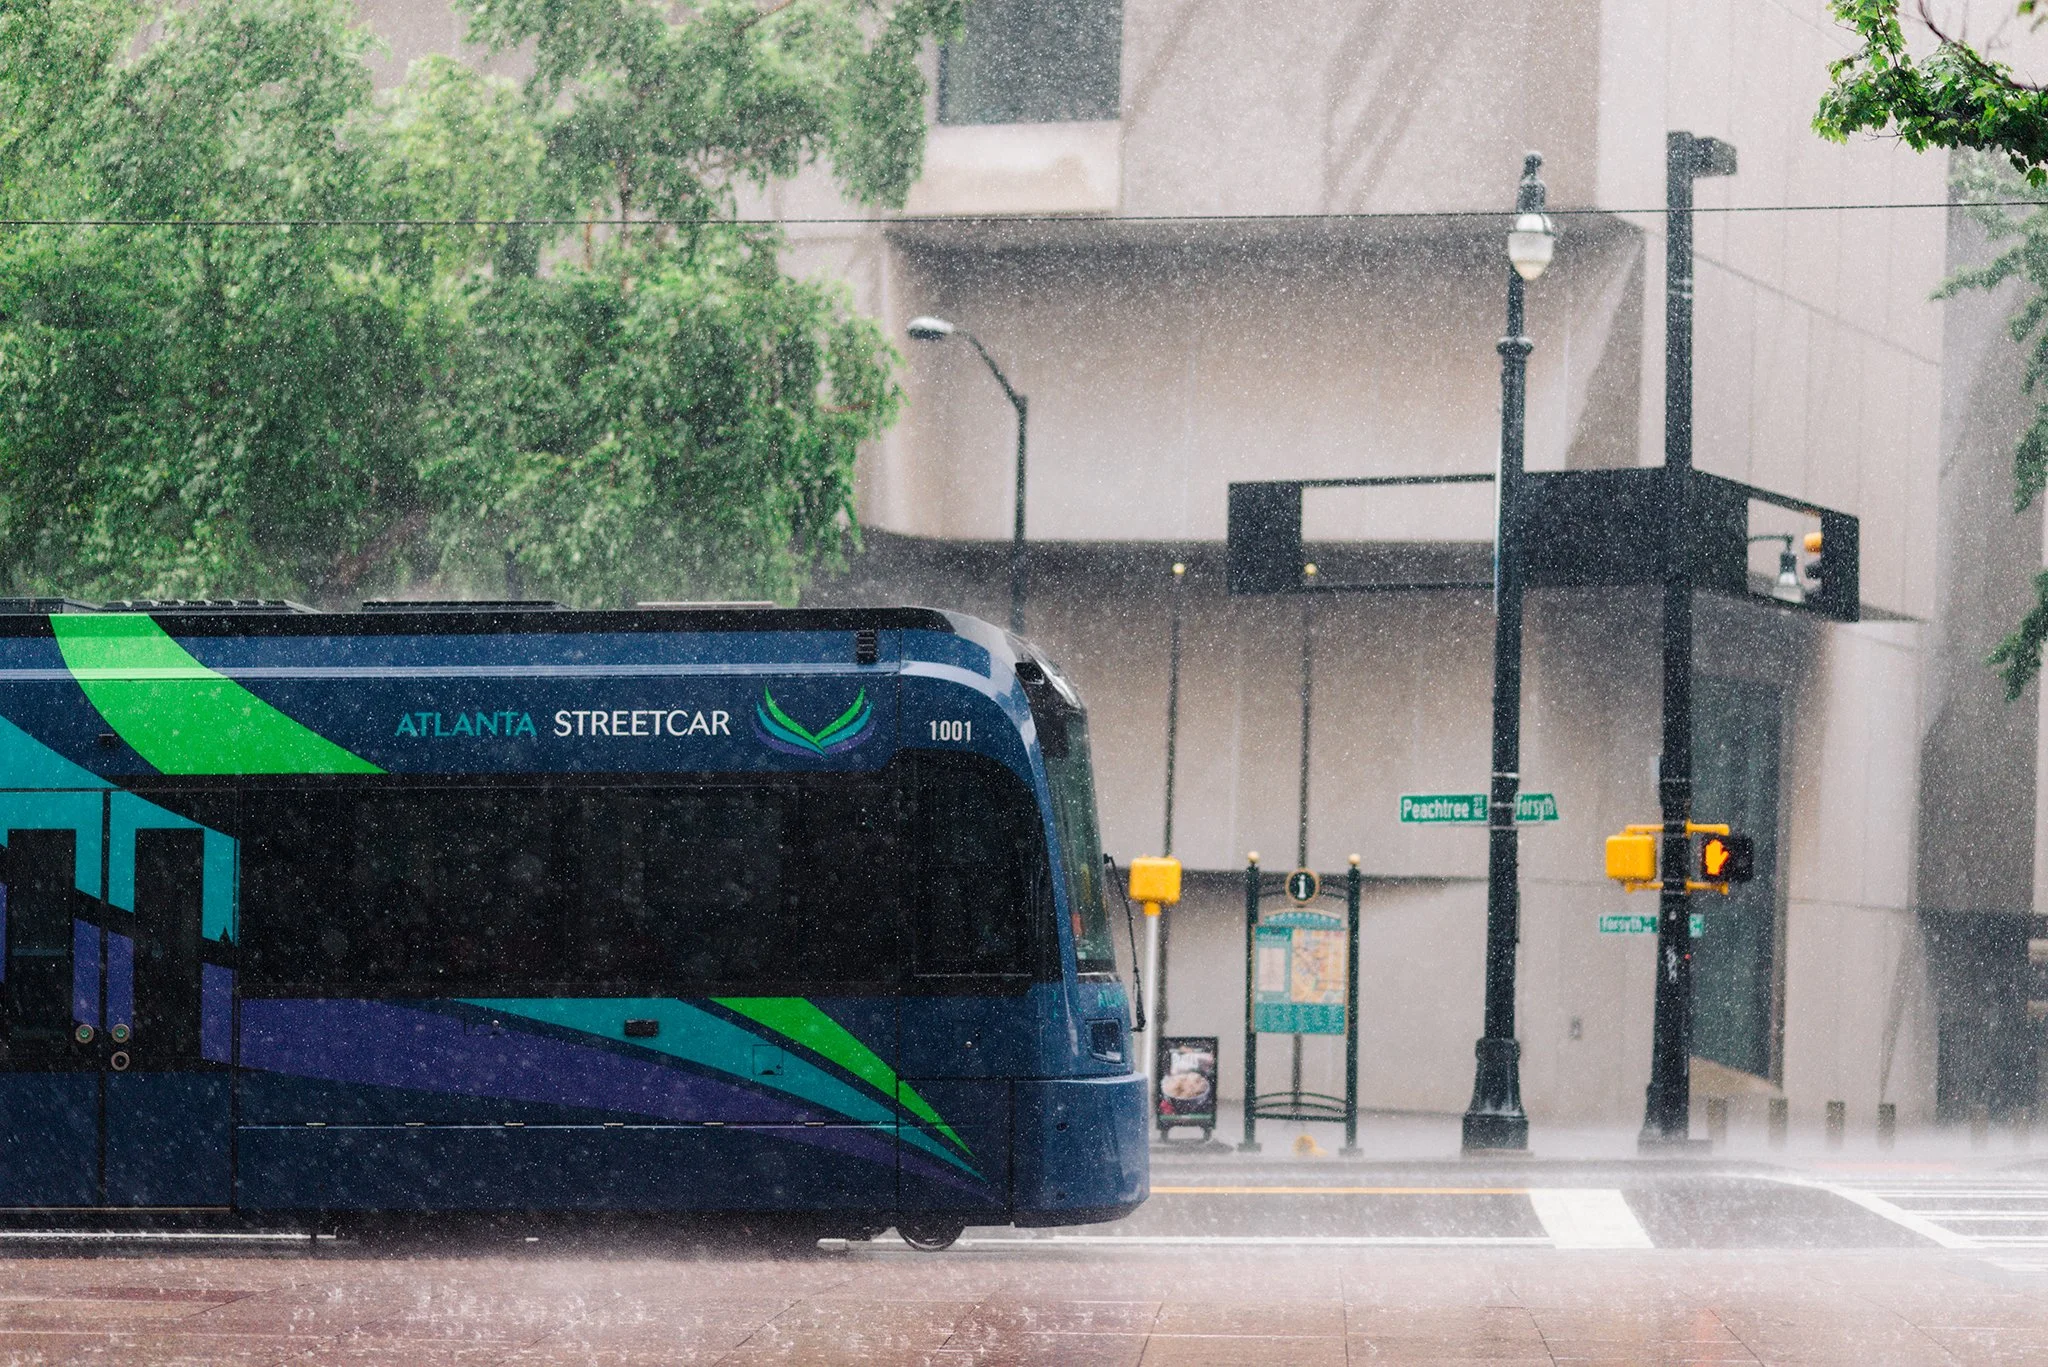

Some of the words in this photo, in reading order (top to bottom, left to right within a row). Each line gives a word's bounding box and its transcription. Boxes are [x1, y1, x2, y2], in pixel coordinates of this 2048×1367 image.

[394, 711, 537, 737] ATLANTA
[553, 709, 731, 737] STREETCAR
[929, 720, 971, 741] 1001
[1403, 799, 1470, 819] Peachtree
